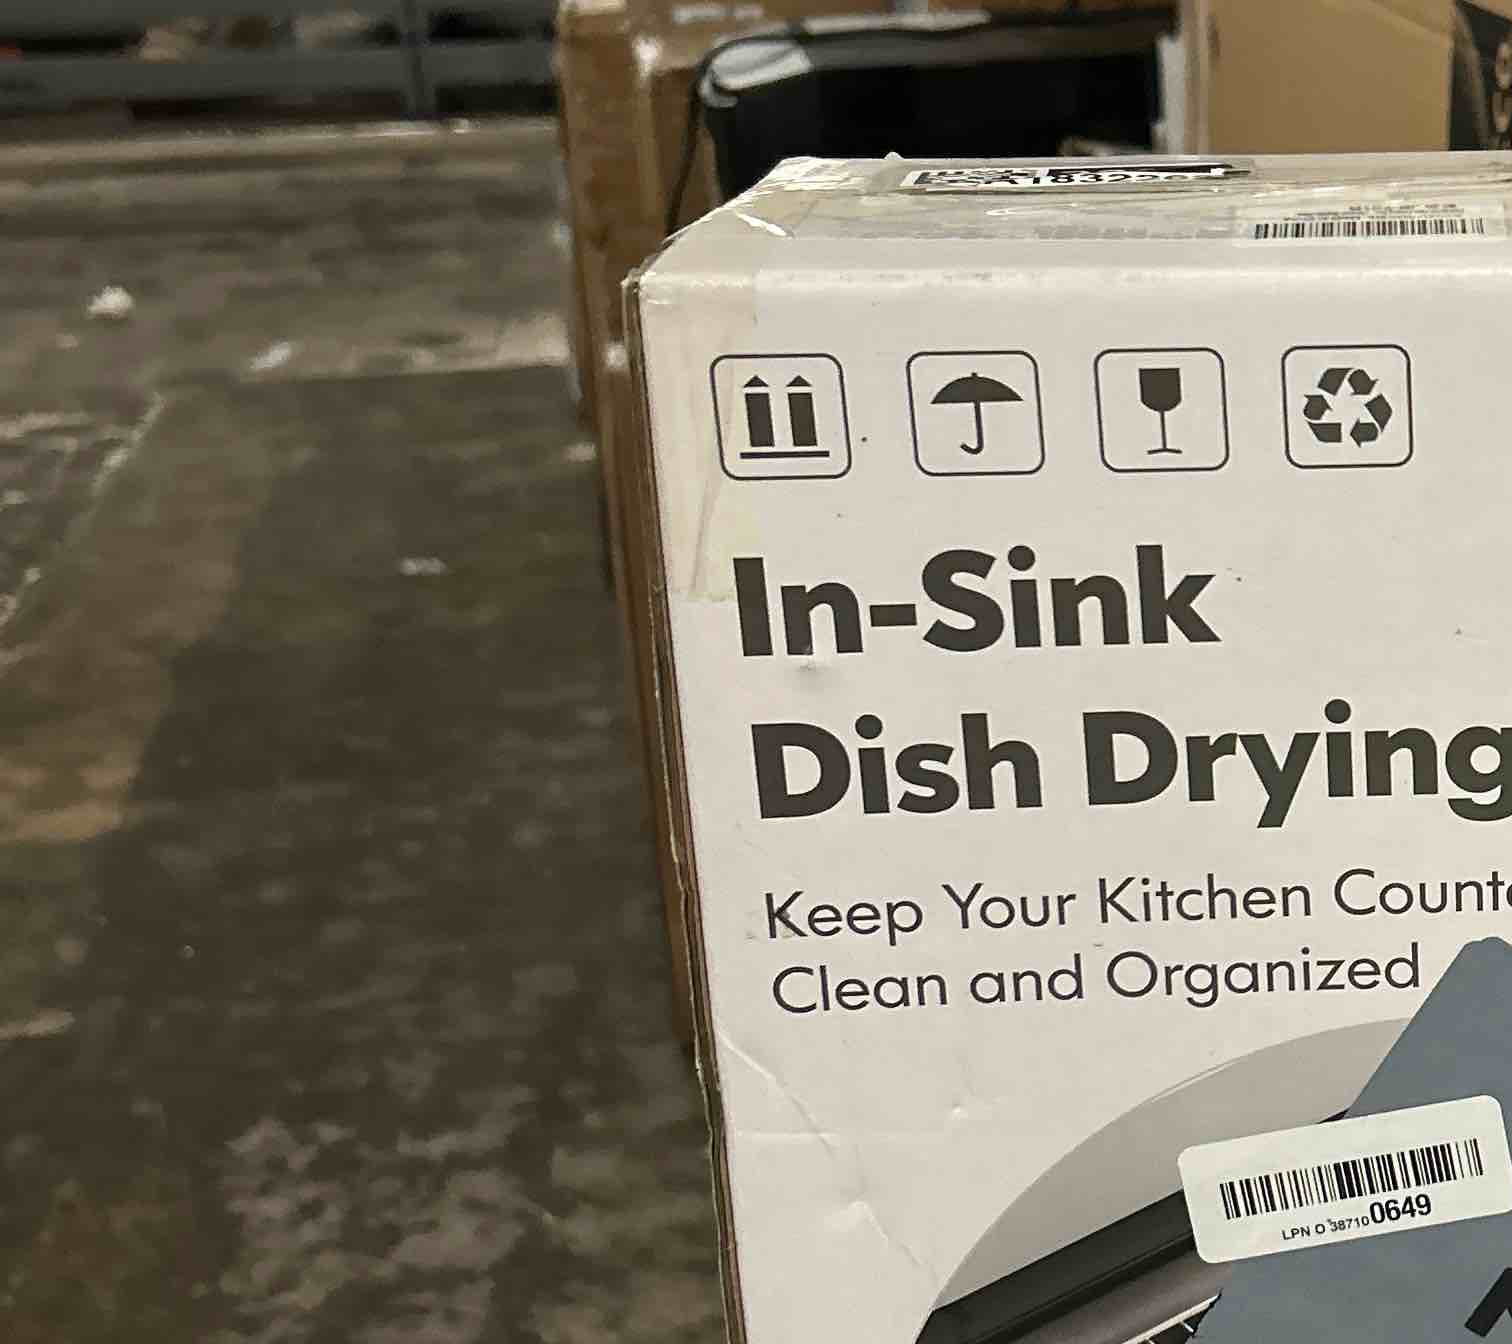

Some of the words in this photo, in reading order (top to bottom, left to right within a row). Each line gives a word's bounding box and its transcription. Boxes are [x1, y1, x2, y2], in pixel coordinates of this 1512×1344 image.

[733, 544, 1222, 657] In-Sink
[751, 713, 1043, 820] Dish
[765, 890, 923, 947] Keep
[942, 882, 1077, 930] Your
[1098, 872, 1312, 924] Kitchen
[772, 964, 948, 1014] Clean
[974, 953, 1084, 1004] and
[1106, 941, 1420, 1009] Organized
[1281, 1225, 1311, 1241] LPN
